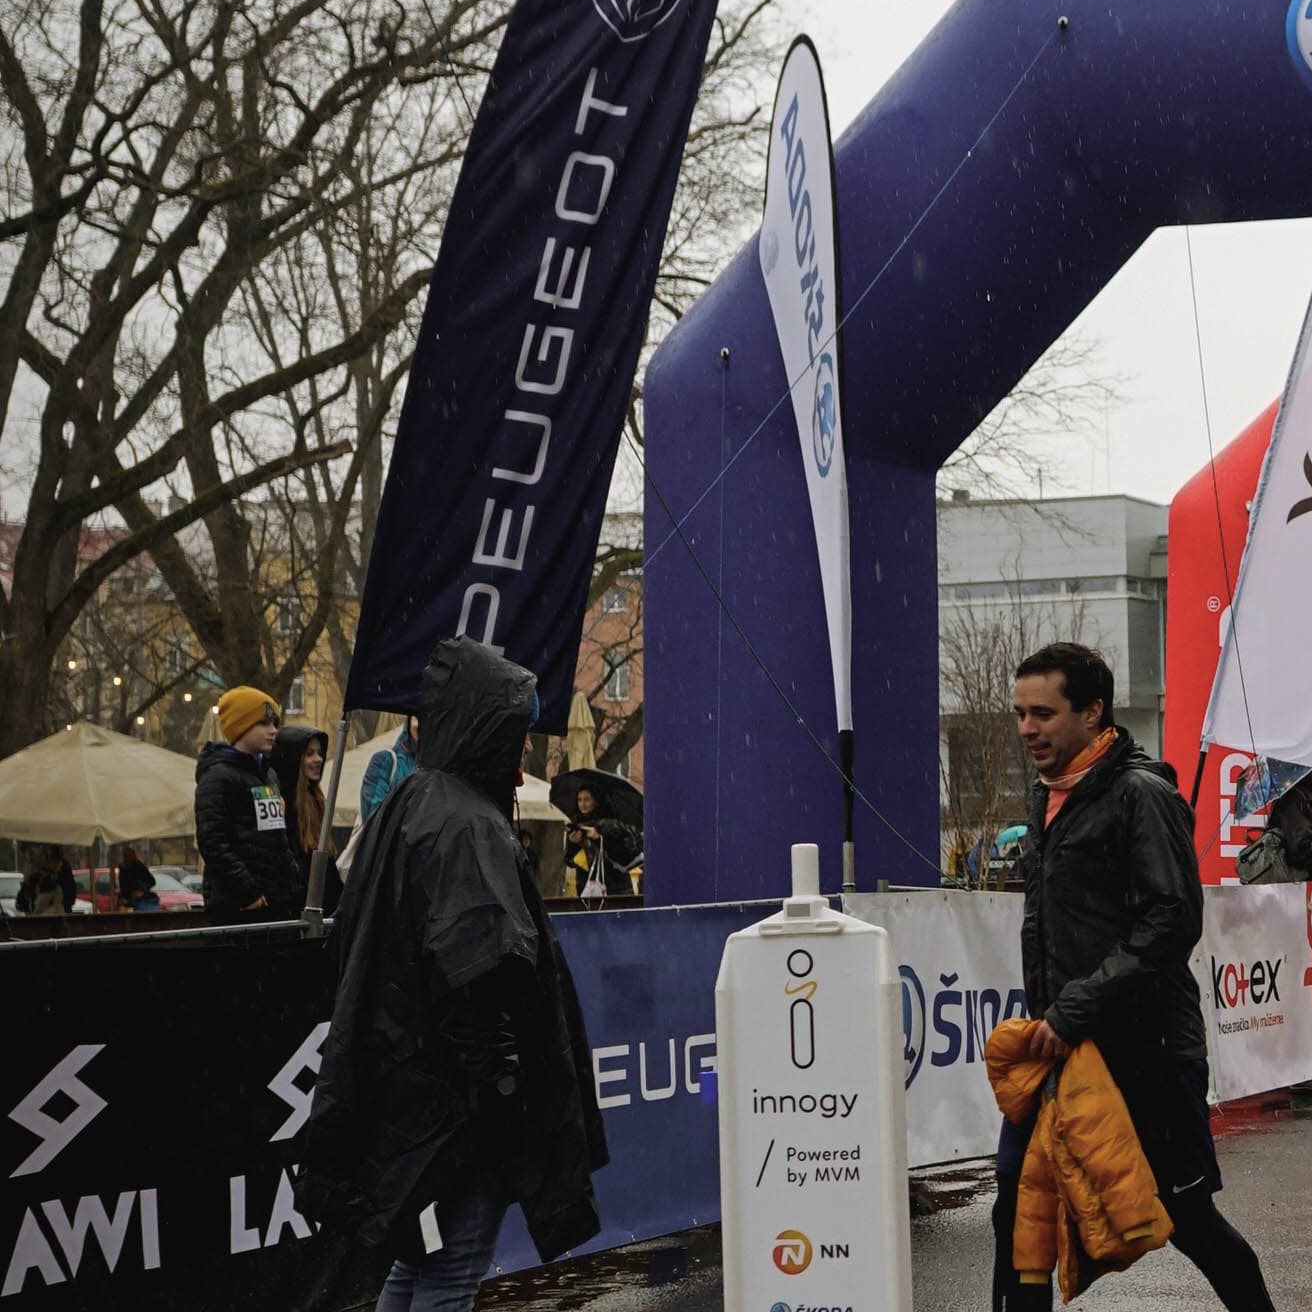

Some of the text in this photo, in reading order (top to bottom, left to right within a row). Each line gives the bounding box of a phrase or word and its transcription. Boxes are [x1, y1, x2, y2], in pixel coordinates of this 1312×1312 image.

[455, 68, 628, 656] PEUGEOT
[1211, 955, 1281, 1009] kotex
[753, 1089, 858, 1118] innogy
[786, 1145, 861, 1162] Powered
[787, 1167, 860, 1187] by MVM
[820, 1244, 850, 1258] NN
